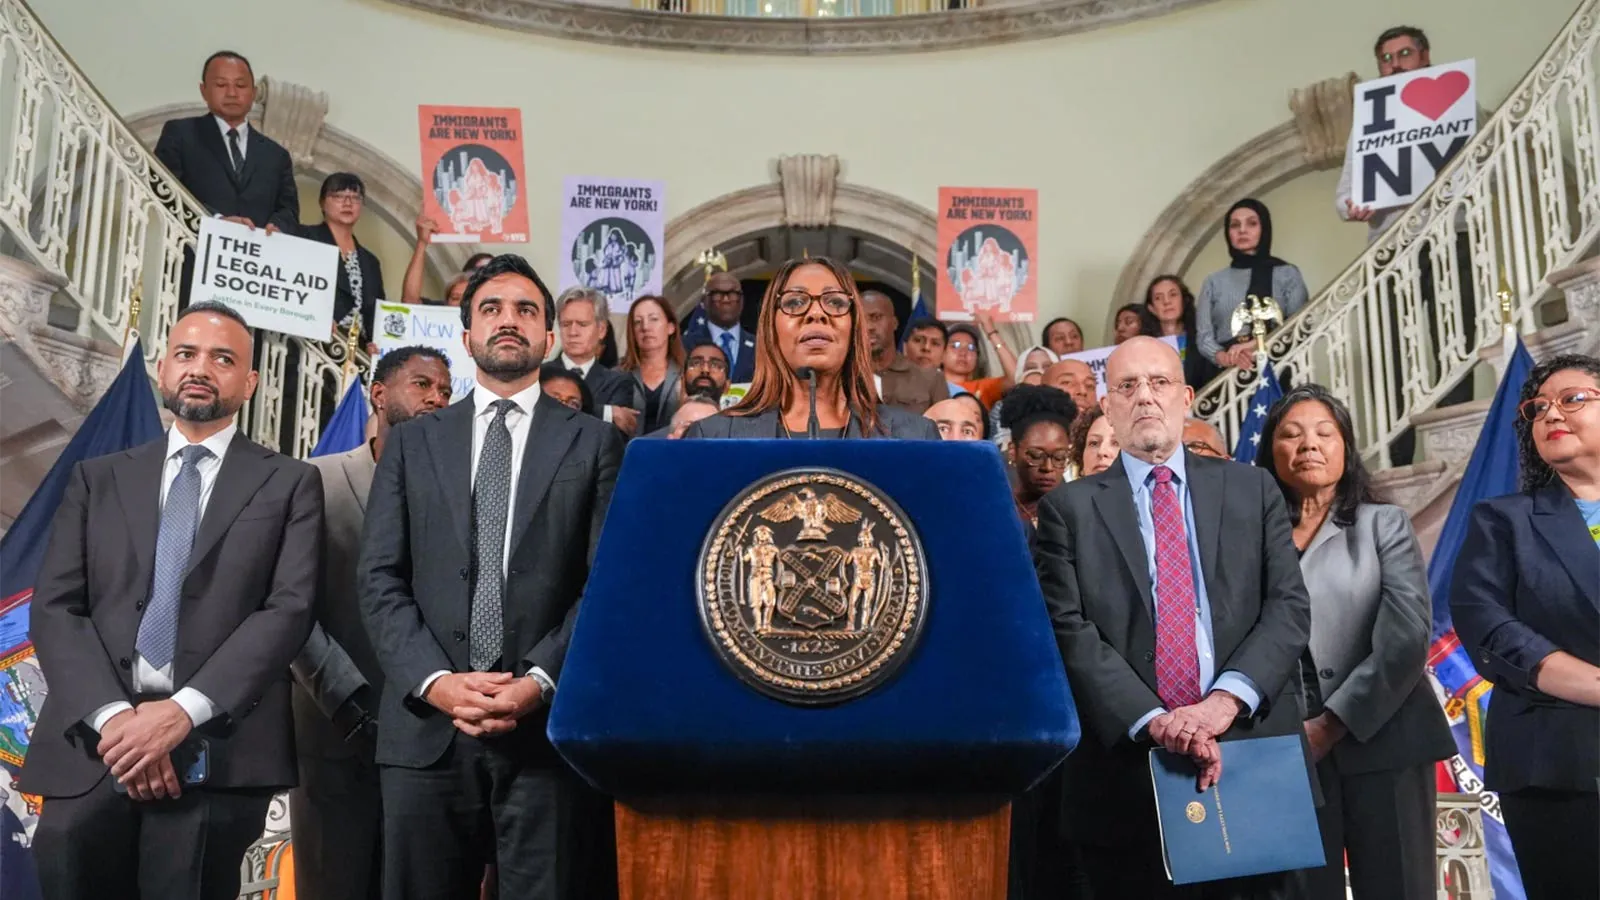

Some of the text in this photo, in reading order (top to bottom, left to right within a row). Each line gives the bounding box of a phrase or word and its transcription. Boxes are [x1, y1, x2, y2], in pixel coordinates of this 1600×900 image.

[1363, 84, 1396, 135] I
[432, 114, 508, 128] IMMIGRANTS
[428, 127, 517, 141] ARE NEW YORK!
[1356, 118, 1473, 153] IMMIGRANT
[1362, 135, 1471, 203] NY
[577, 184, 652, 199] IMMIGRANTS
[570, 196, 658, 212] ARE NEW YORK!
[952, 196, 1024, 209] IMMIGRANTS
[947, 208, 1032, 221] ARE NEW YORK!
[218, 235, 262, 257] THE
[216, 254, 329, 291] LEGAL AID
[213, 273, 309, 306] SOCIETY
[211, 293, 243, 306] Justice
[243, 299, 253, 309] in
[254, 302, 279, 314] Every
[412, 314, 454, 338] New
